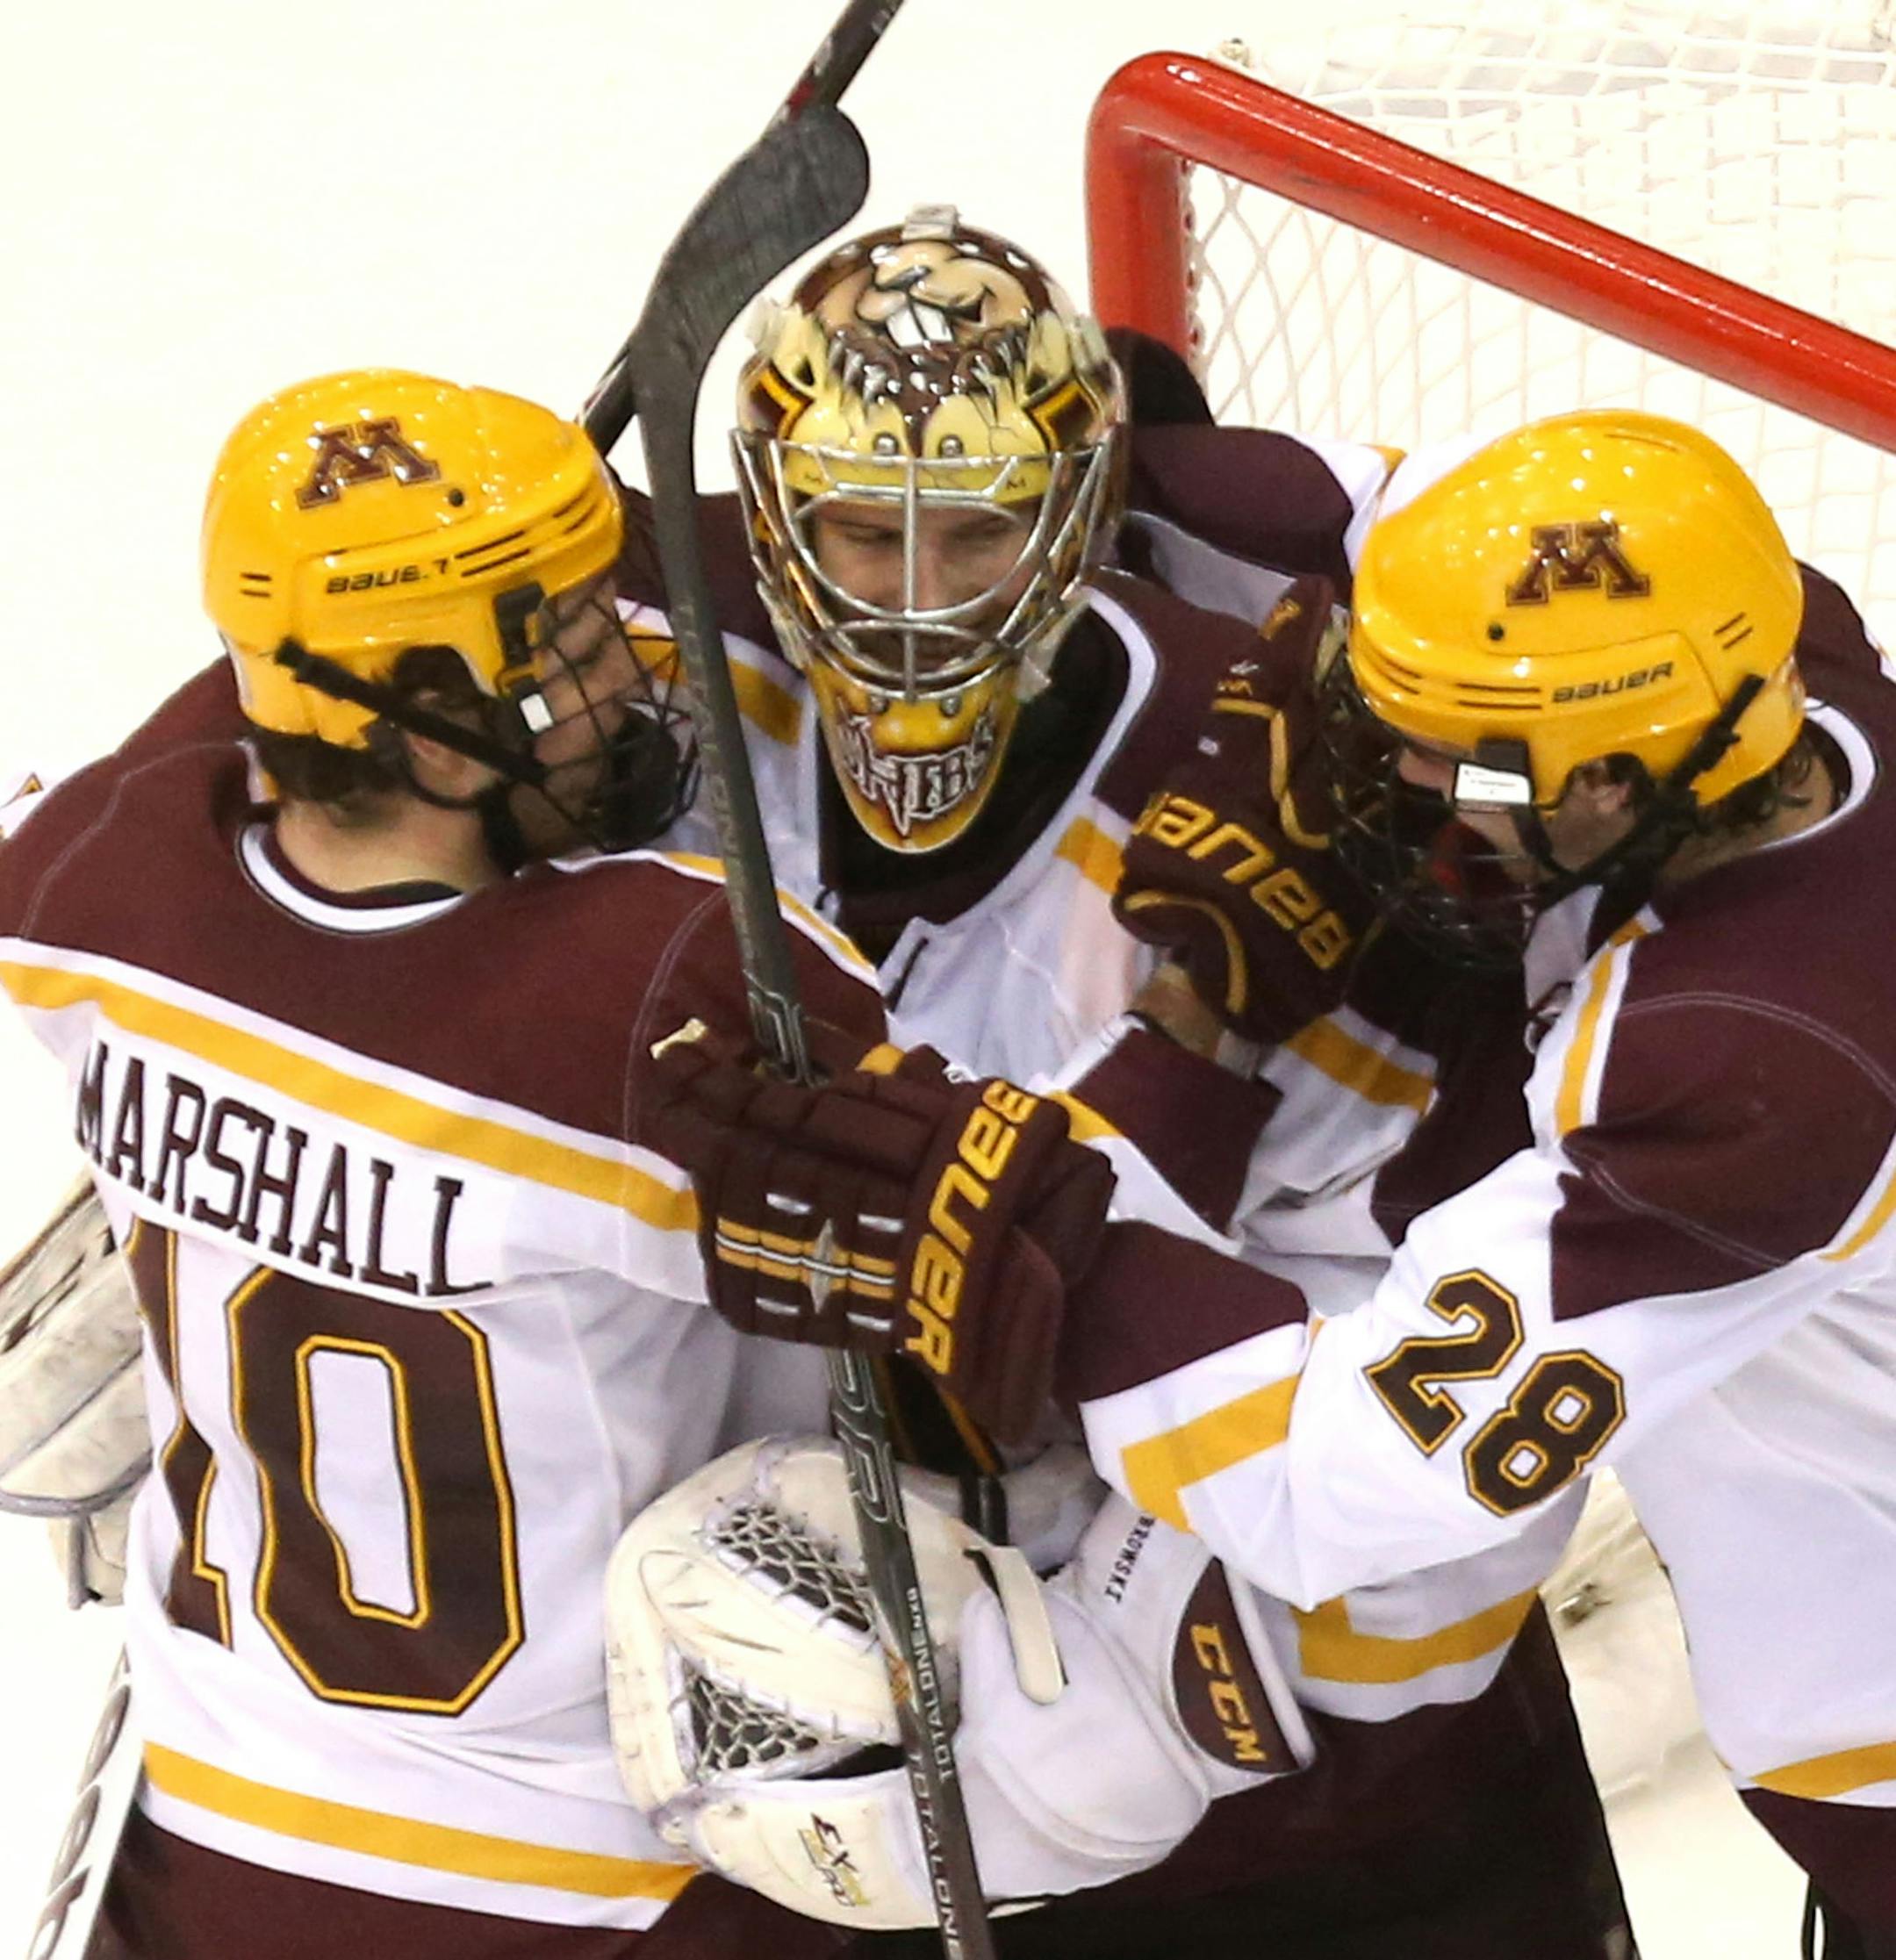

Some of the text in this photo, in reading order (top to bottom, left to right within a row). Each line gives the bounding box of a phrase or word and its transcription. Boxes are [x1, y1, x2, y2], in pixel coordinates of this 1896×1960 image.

[294, 416, 442, 510] M
[1505, 520, 1651, 607] M
[1552, 660, 1674, 703] BAUER
[75, 1040, 493, 1296] MARSHALL
[905, 1078, 1041, 1375] BAUER
[123, 1213, 527, 1716] 10
[1362, 1267, 1627, 1517] 28
[1190, 1625, 1268, 1763] CCM
